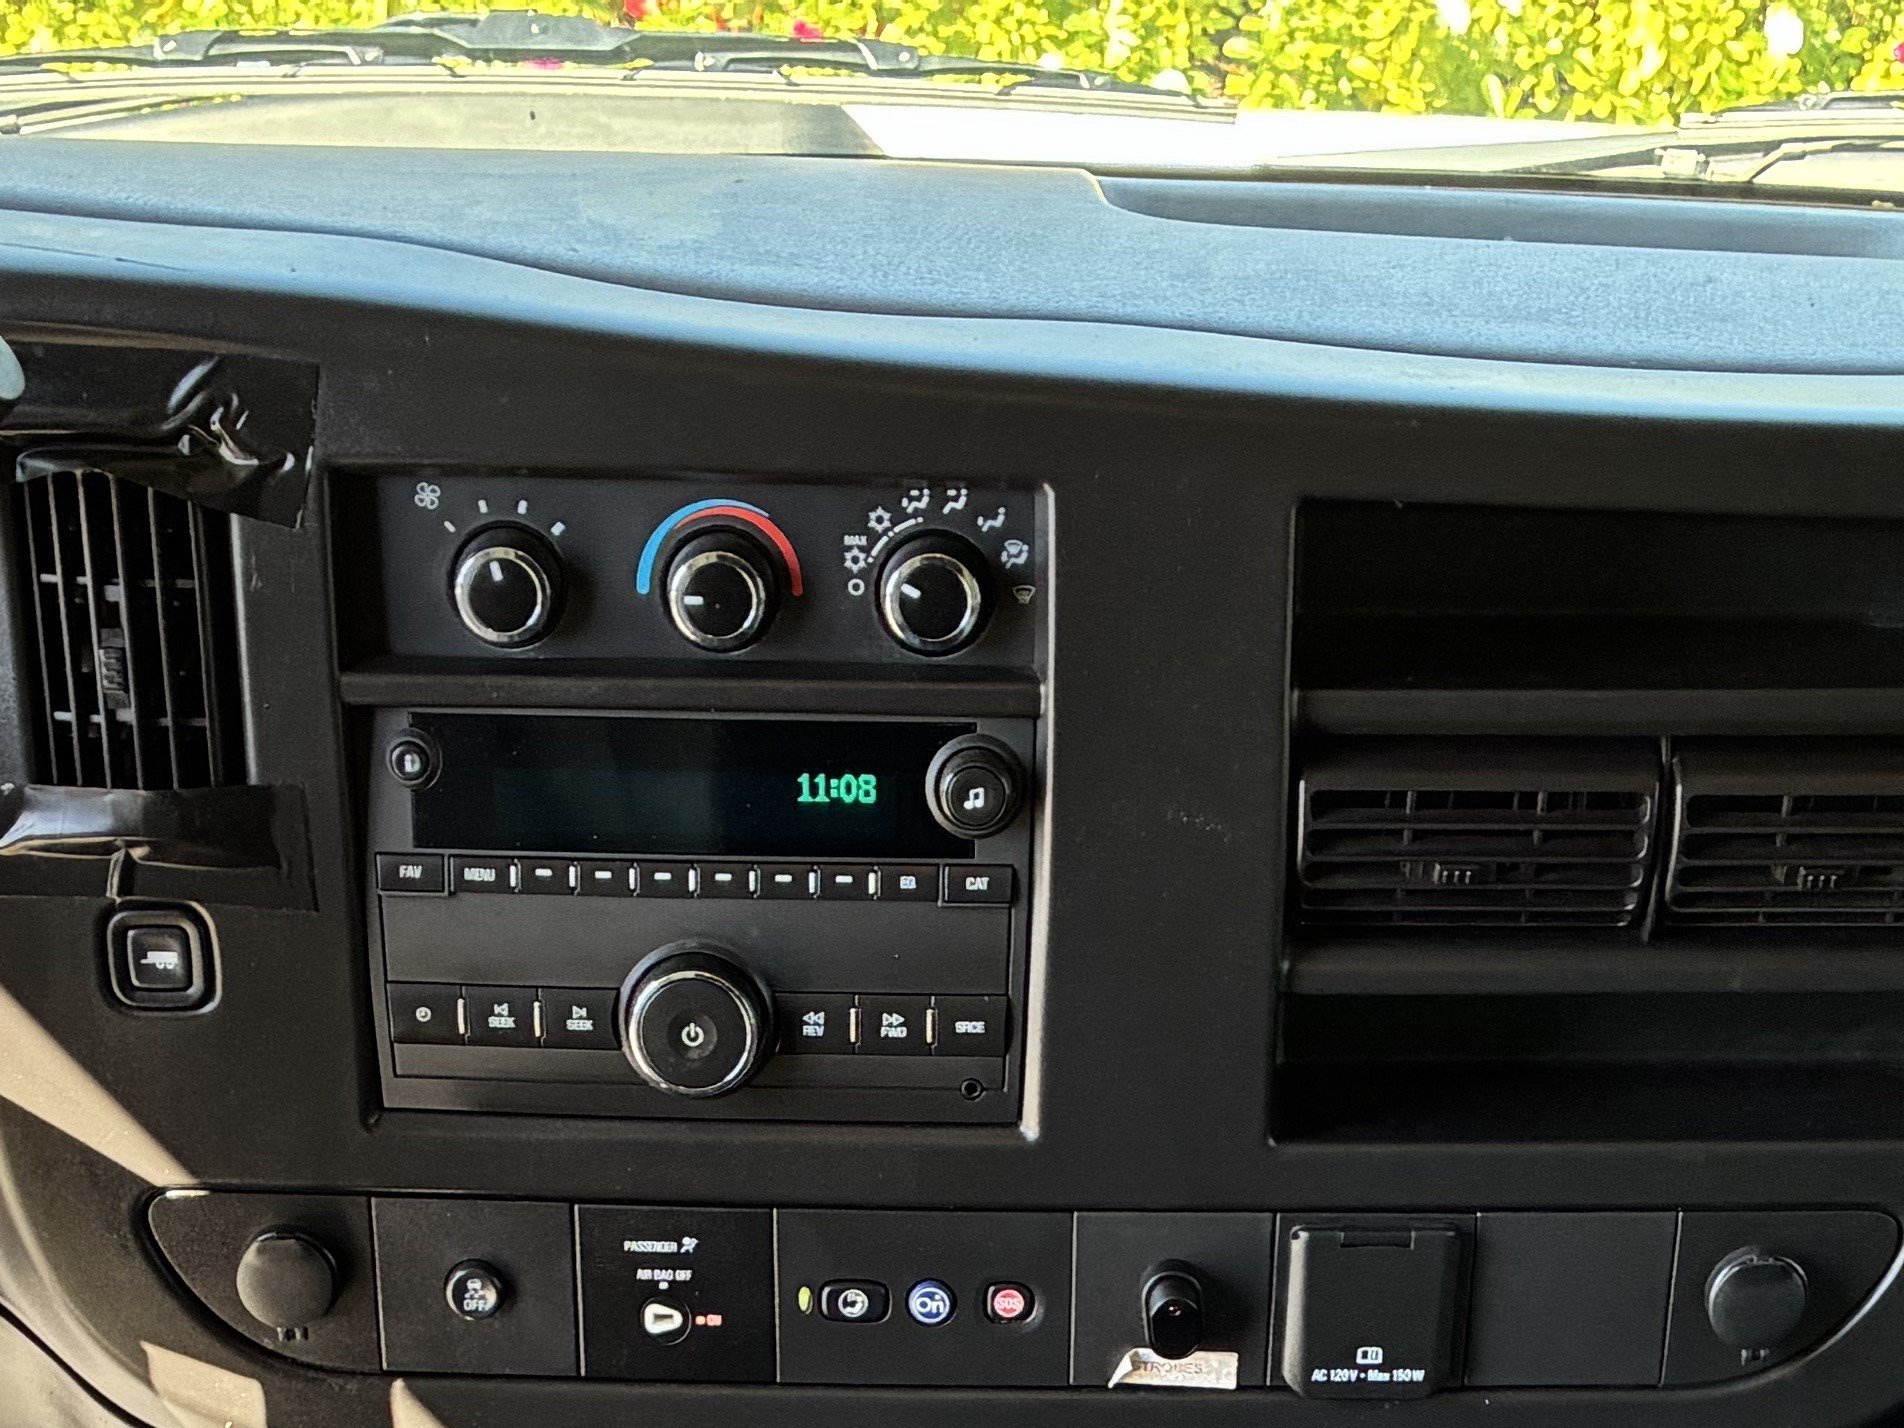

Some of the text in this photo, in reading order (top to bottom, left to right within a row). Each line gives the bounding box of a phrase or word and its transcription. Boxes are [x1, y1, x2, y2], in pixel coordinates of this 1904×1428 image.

[843, 534, 868, 546] MAX
[797, 772, 878, 804] 11:08
[399, 865, 423, 879] FAV
[463, 867, 496, 882] MENU
[965, 876, 990, 891] CAT
[488, 1015, 516, 1028] SEEK
[566, 1019, 594, 1031] SEEK
[802, 1025, 825, 1037] REV
[880, 1026, 908, 1038] FWD
[994, 1296, 1024, 1311] SOS
[1311, 1369, 1328, 1381] AC
[1367, 1369, 1389, 1381] Max
